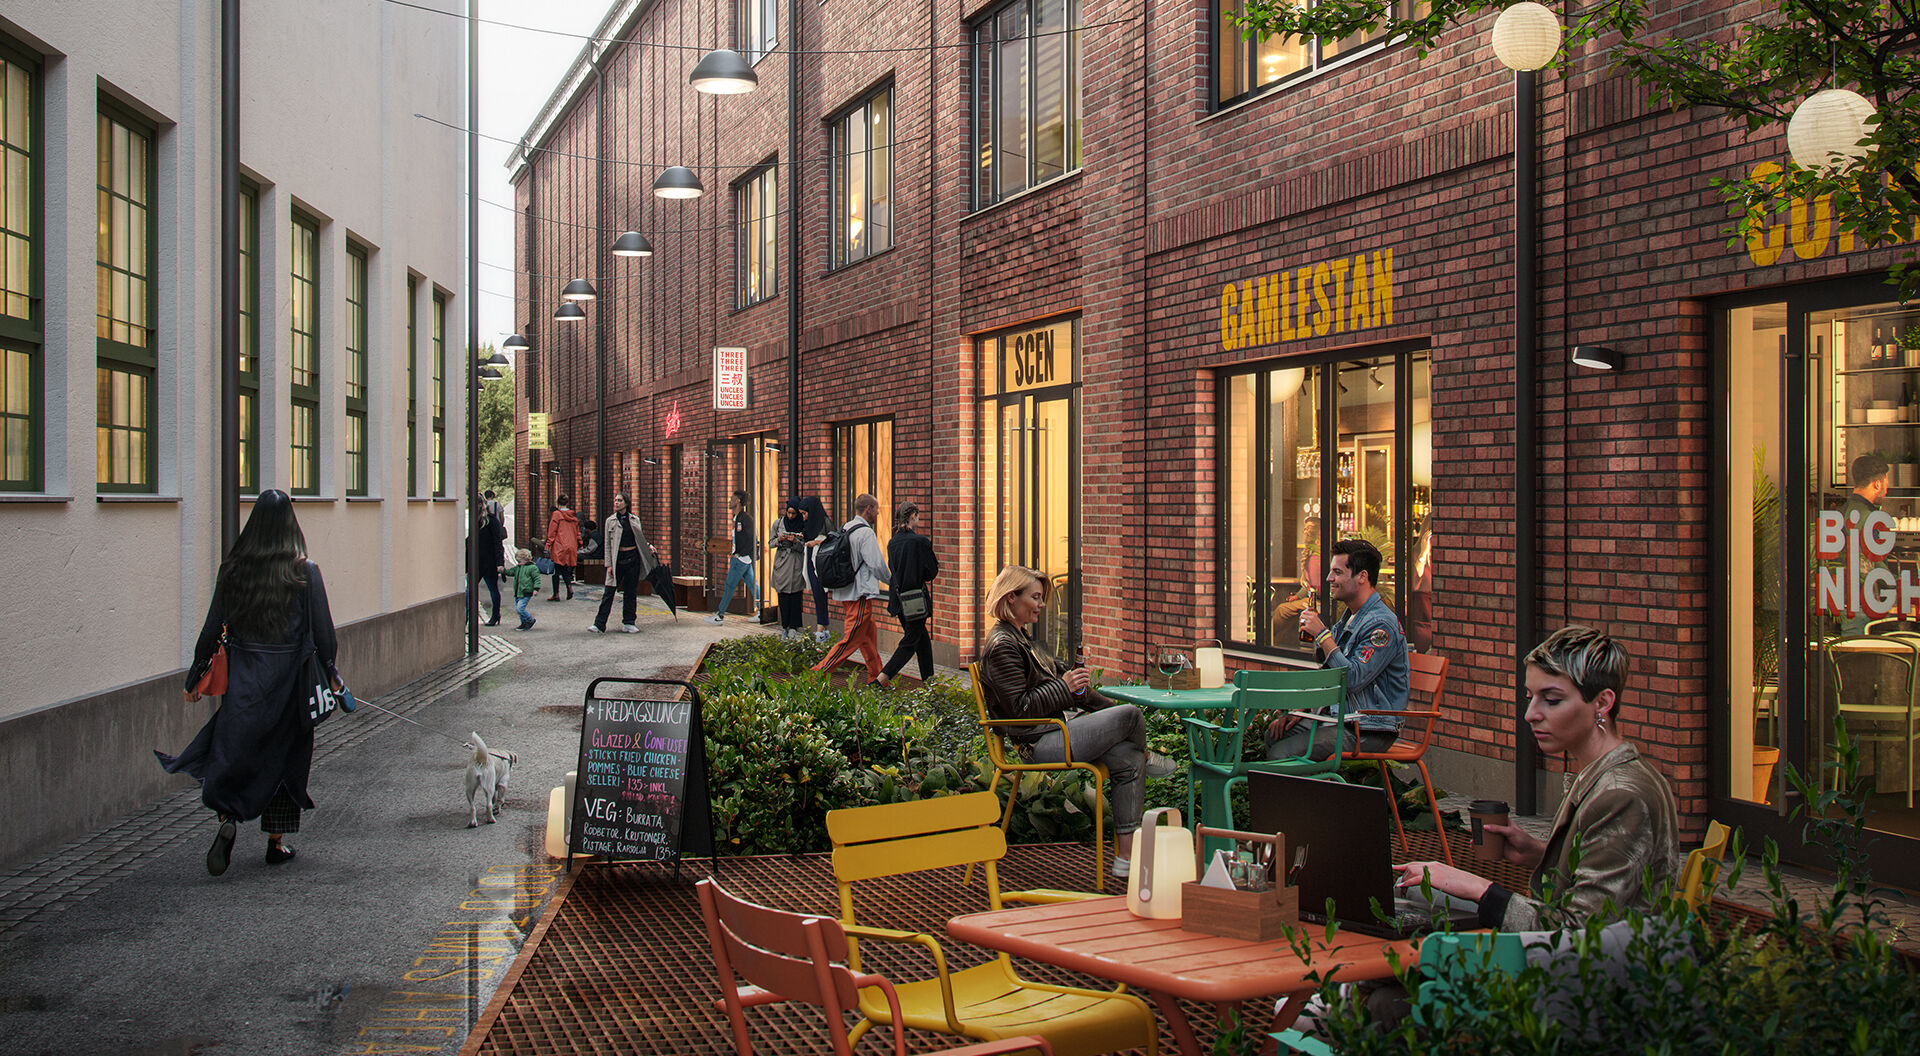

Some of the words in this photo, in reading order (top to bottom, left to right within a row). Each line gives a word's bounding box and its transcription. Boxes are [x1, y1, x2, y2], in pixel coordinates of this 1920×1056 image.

[1221, 248, 1394, 351] GAMLESTAN
[1015, 329, 1054, 386] SCEN
[722, 373, 743, 385] 三叔
[598, 701, 690, 724] FREDAGSLUNCH
[632, 732, 642, 750] &
[588, 749, 617, 762] STICKY
[619, 750, 642, 765] FRIED
[643, 751, 677, 766] CHICKEN
[586, 773, 620, 787] SELLERI
[587, 760, 621, 775] POMMES
[627, 764, 648, 778] BLUE
[649, 767, 681, 781] CHEESE
[459, 863, 564, 911] GOOD
